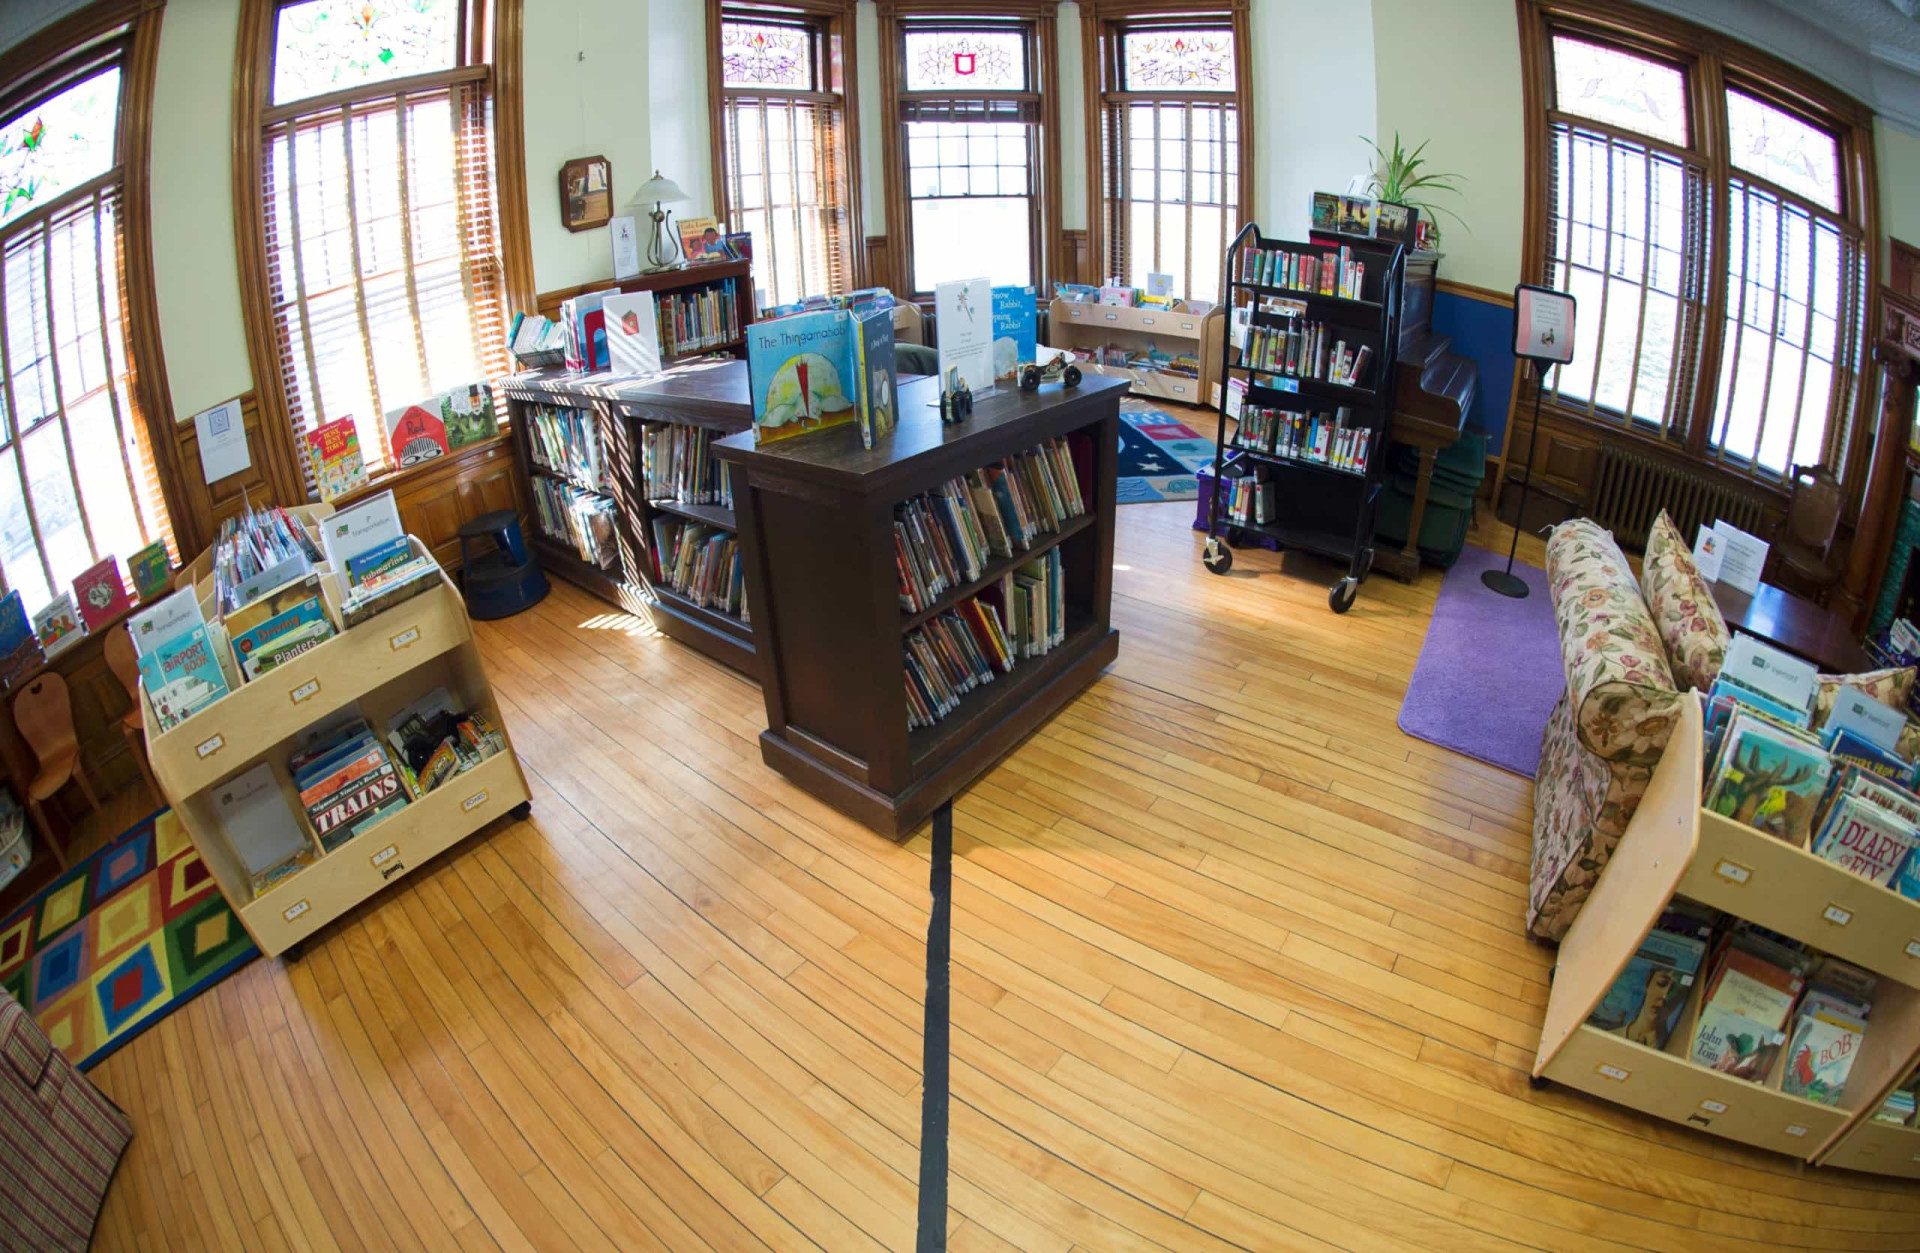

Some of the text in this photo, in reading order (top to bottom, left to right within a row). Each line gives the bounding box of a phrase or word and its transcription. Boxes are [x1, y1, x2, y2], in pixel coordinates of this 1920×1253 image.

[759, 336, 777, 349] The
[780, 326, 846, 347] Thingamabob
[406, 417, 426, 435] Red
[361, 552, 408, 581] Submarines
[256, 615, 300, 642] Driving
[183, 652, 209, 675] BOOK
[274, 637, 317, 665] Planters
[312, 771, 380, 812] Seymour Simon's Book
[315, 774, 398, 834] TRAINS
[1839, 820, 1907, 868] DIARY
[1697, 1025, 1723, 1046] John
[1820, 1031, 1853, 1066] BOB
[1698, 1041, 1720, 1061] Tom
